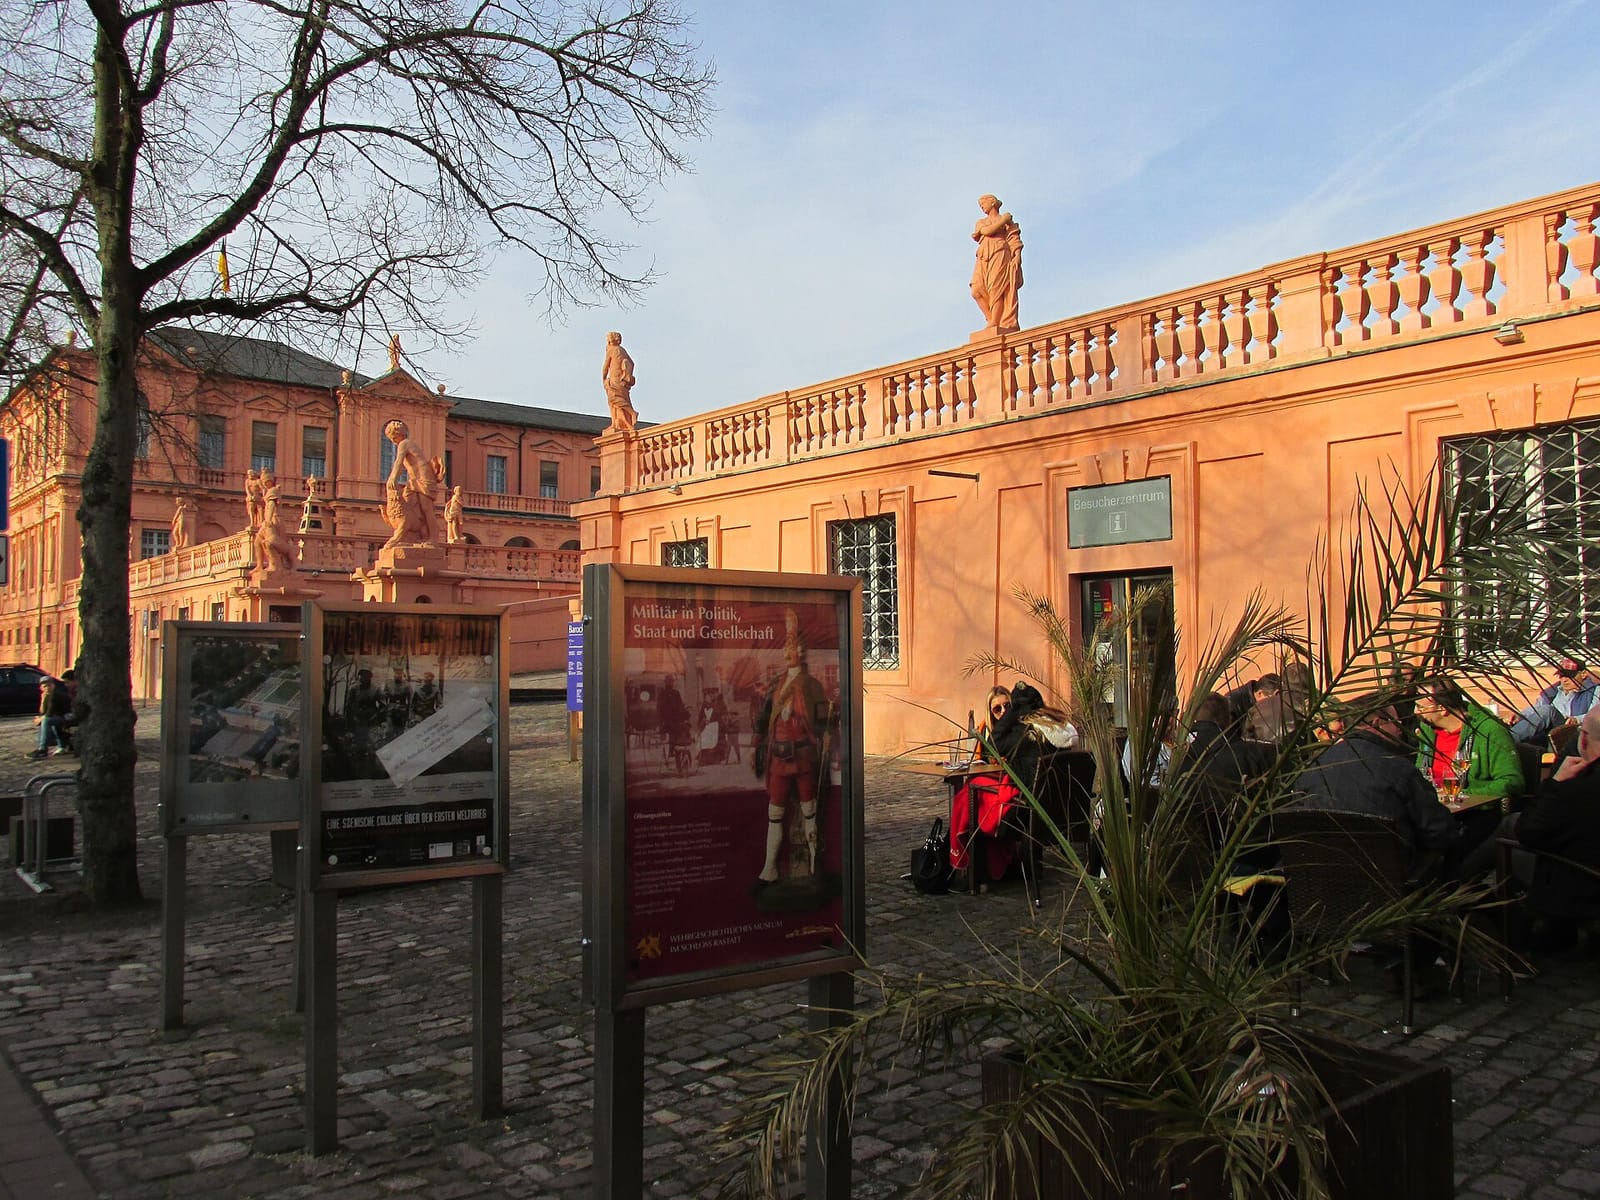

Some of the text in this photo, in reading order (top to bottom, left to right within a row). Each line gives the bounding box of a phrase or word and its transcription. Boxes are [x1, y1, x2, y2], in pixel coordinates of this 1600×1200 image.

[1073, 491, 1164, 511] Besucherzentrum
[632, 604, 742, 623] Militär in Politik,
[633, 623, 774, 640] Staat und Gesellschaft
[404, 811, 420, 825] ÜBER
